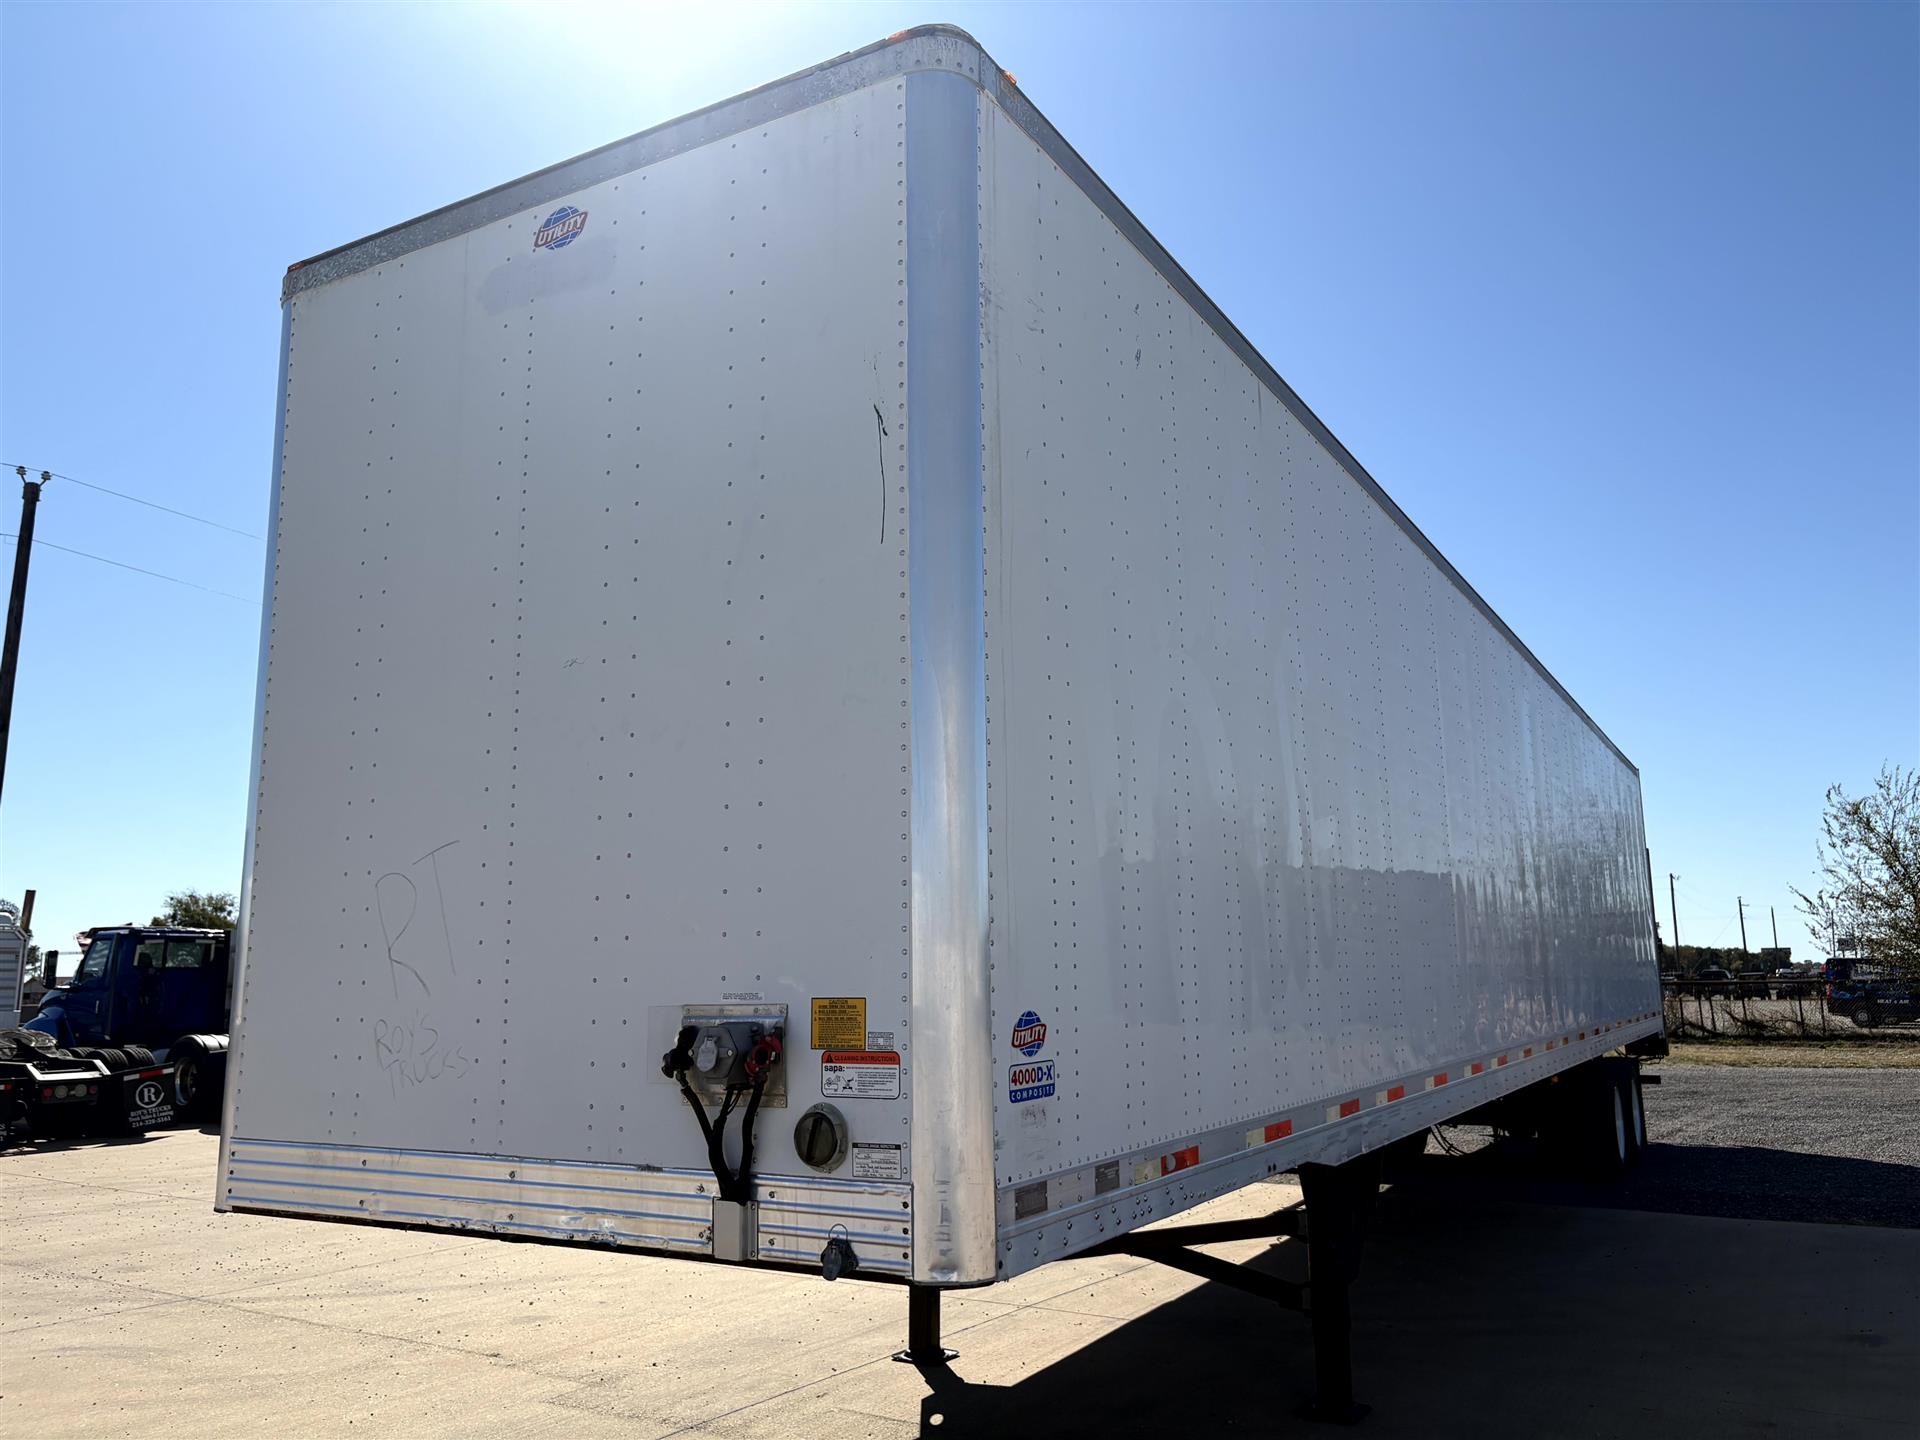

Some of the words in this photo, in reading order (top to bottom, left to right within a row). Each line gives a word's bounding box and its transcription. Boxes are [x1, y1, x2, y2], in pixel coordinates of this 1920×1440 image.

[537, 212, 586, 245] UTILITY
[374, 839, 461, 1001] RT
[1013, 1026, 1046, 1046] UTILITY
[859, 1055, 896, 1063] INSTRUCTIONS
[1011, 1065, 1053, 1087] 4000D-X
[1011, 1086, 1054, 1100] COMPOSITE
